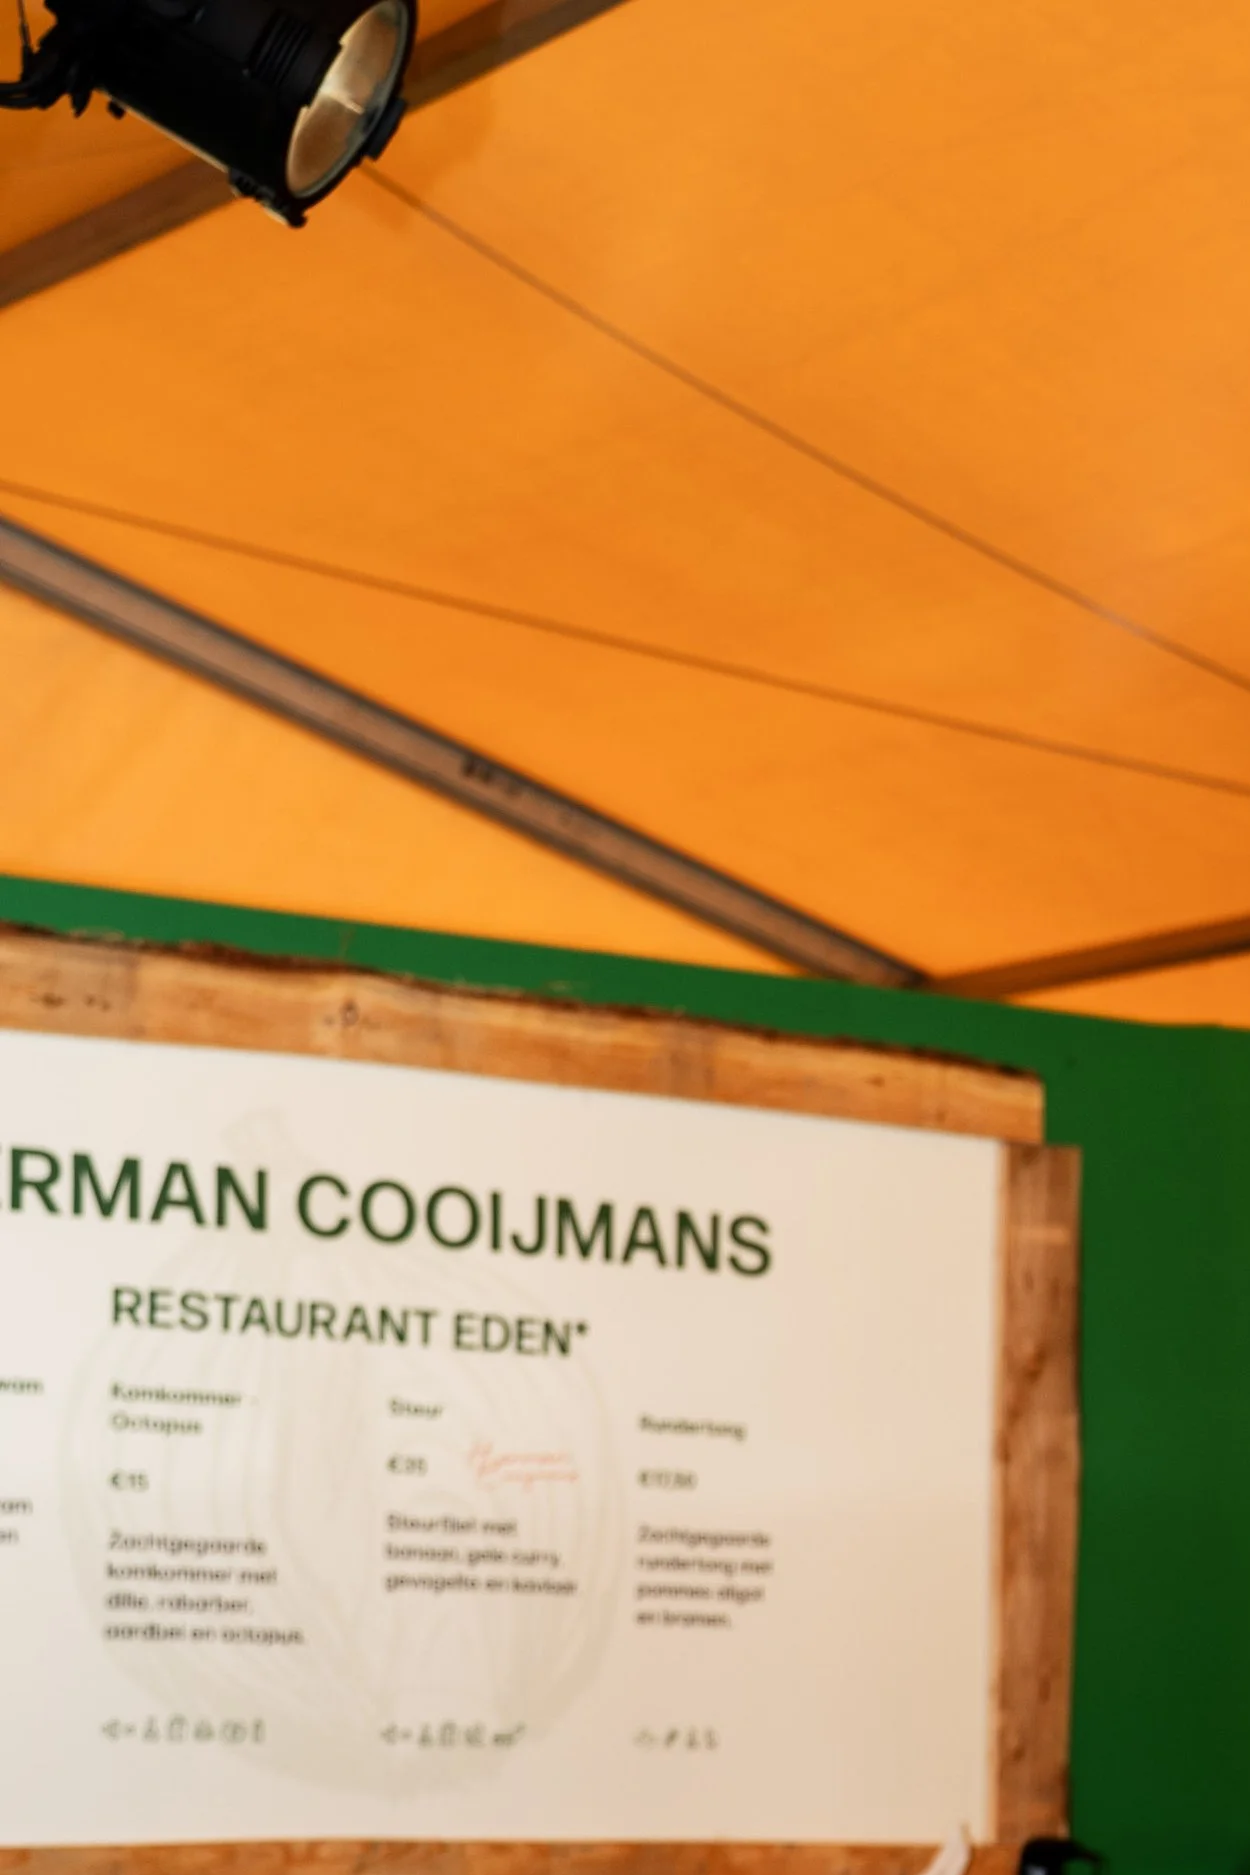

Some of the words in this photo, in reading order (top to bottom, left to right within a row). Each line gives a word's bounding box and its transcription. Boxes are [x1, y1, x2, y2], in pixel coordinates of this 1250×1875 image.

[0, 1145, 268, 1233] RMAN
[296, 1172, 773, 1278] COOIJMANS
[111, 1285, 439, 1347] RESTAURANT
[110, 1412, 203, 1438] Octopus
